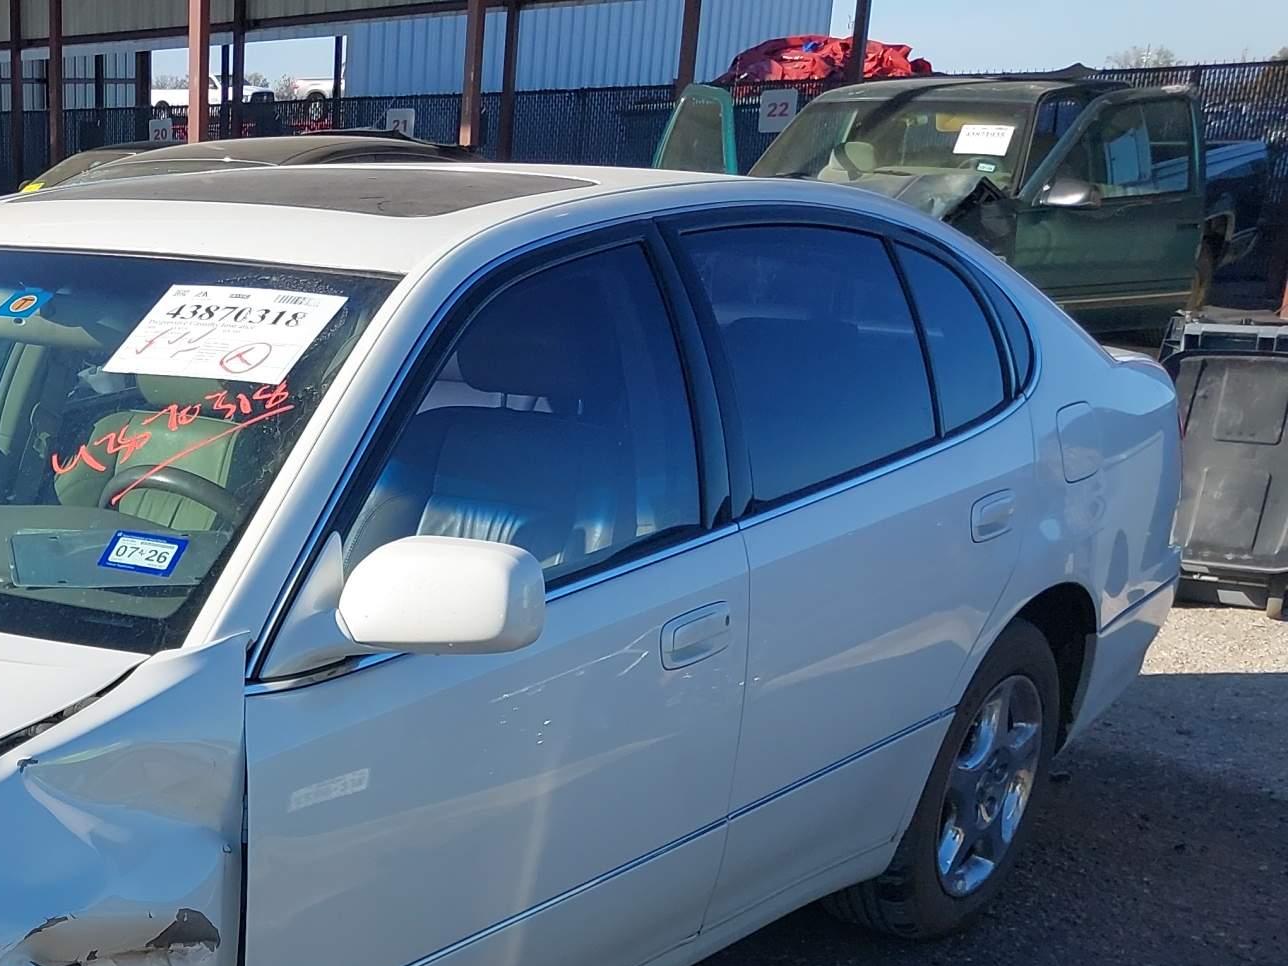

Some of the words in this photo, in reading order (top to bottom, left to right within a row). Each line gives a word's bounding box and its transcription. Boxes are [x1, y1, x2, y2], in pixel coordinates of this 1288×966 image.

[767, 102, 789, 117] 22
[392, 119, 408, 132] 21
[154, 128, 168, 140] 20
[166, 303, 307, 327] 43870318
[115, 544, 140, 559] 07
[145, 549, 171, 564] 26
